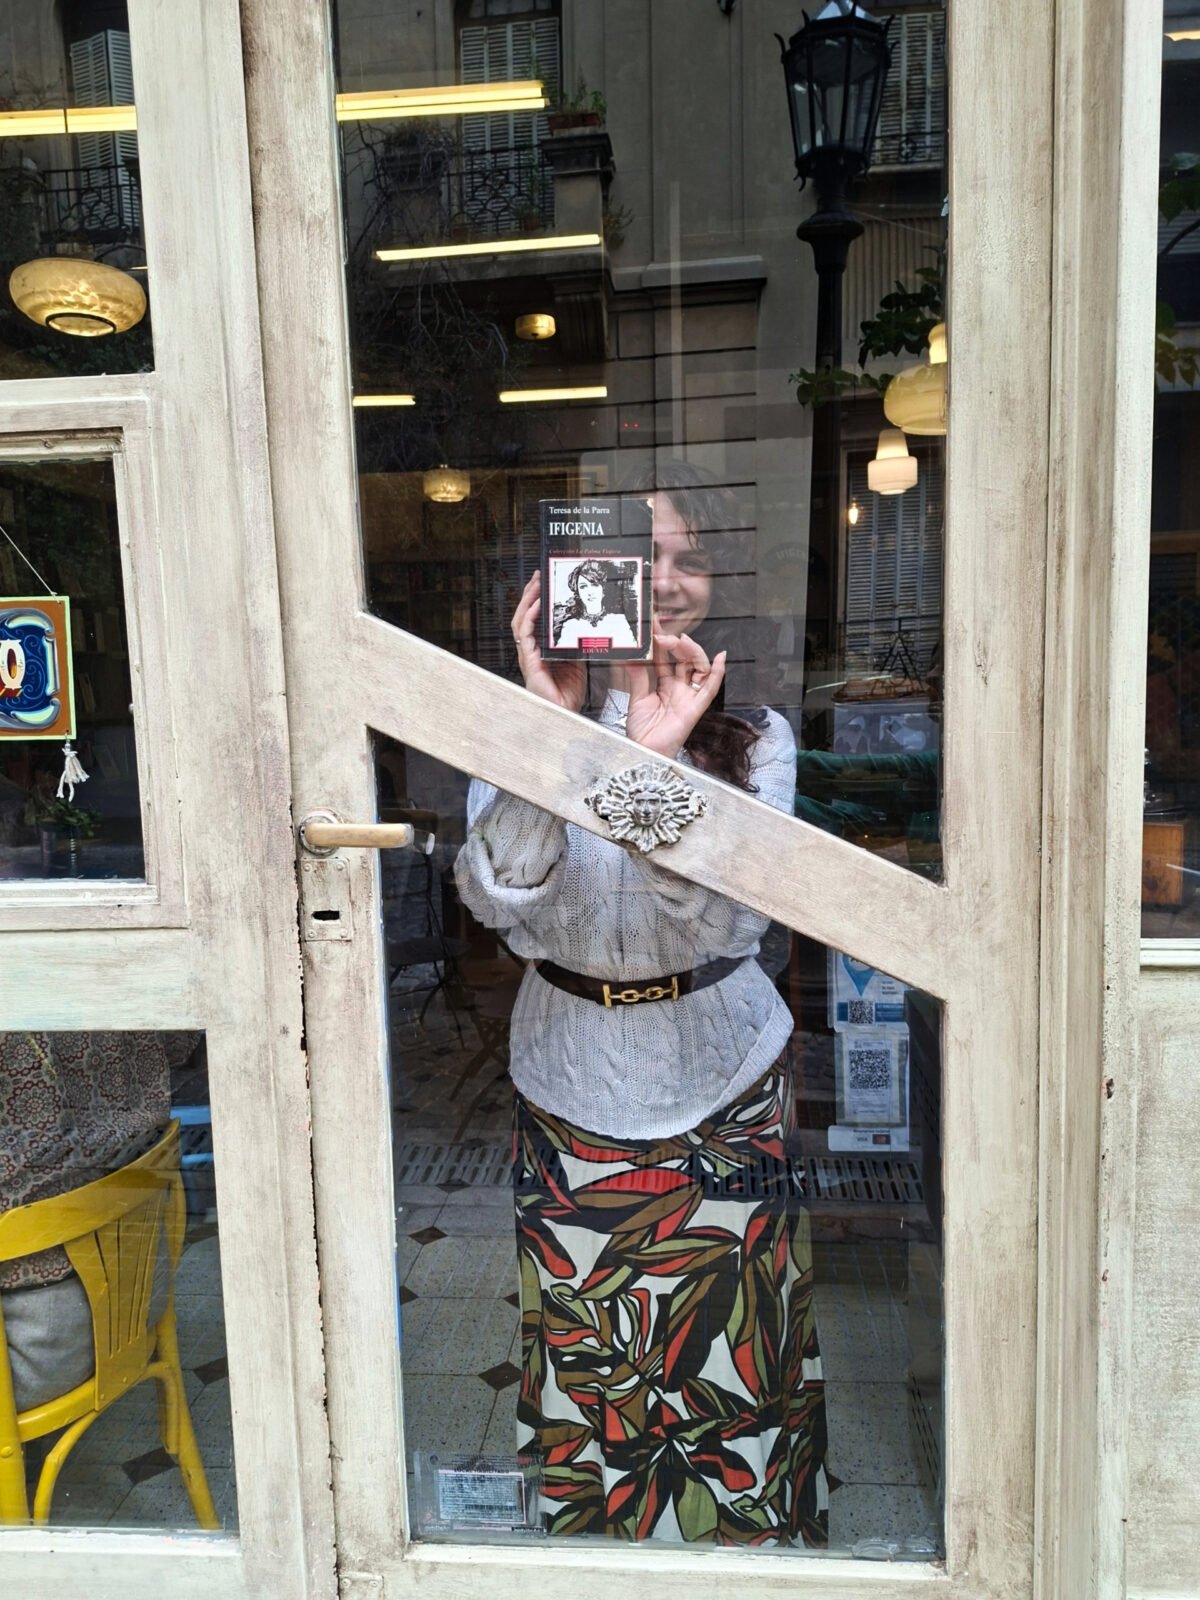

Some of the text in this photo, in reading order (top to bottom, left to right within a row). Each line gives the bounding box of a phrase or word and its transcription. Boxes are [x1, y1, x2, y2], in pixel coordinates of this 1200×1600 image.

[549, 506, 610, 514] Teresa de la Parra
[549, 521, 604, 536] IFIGENIA
